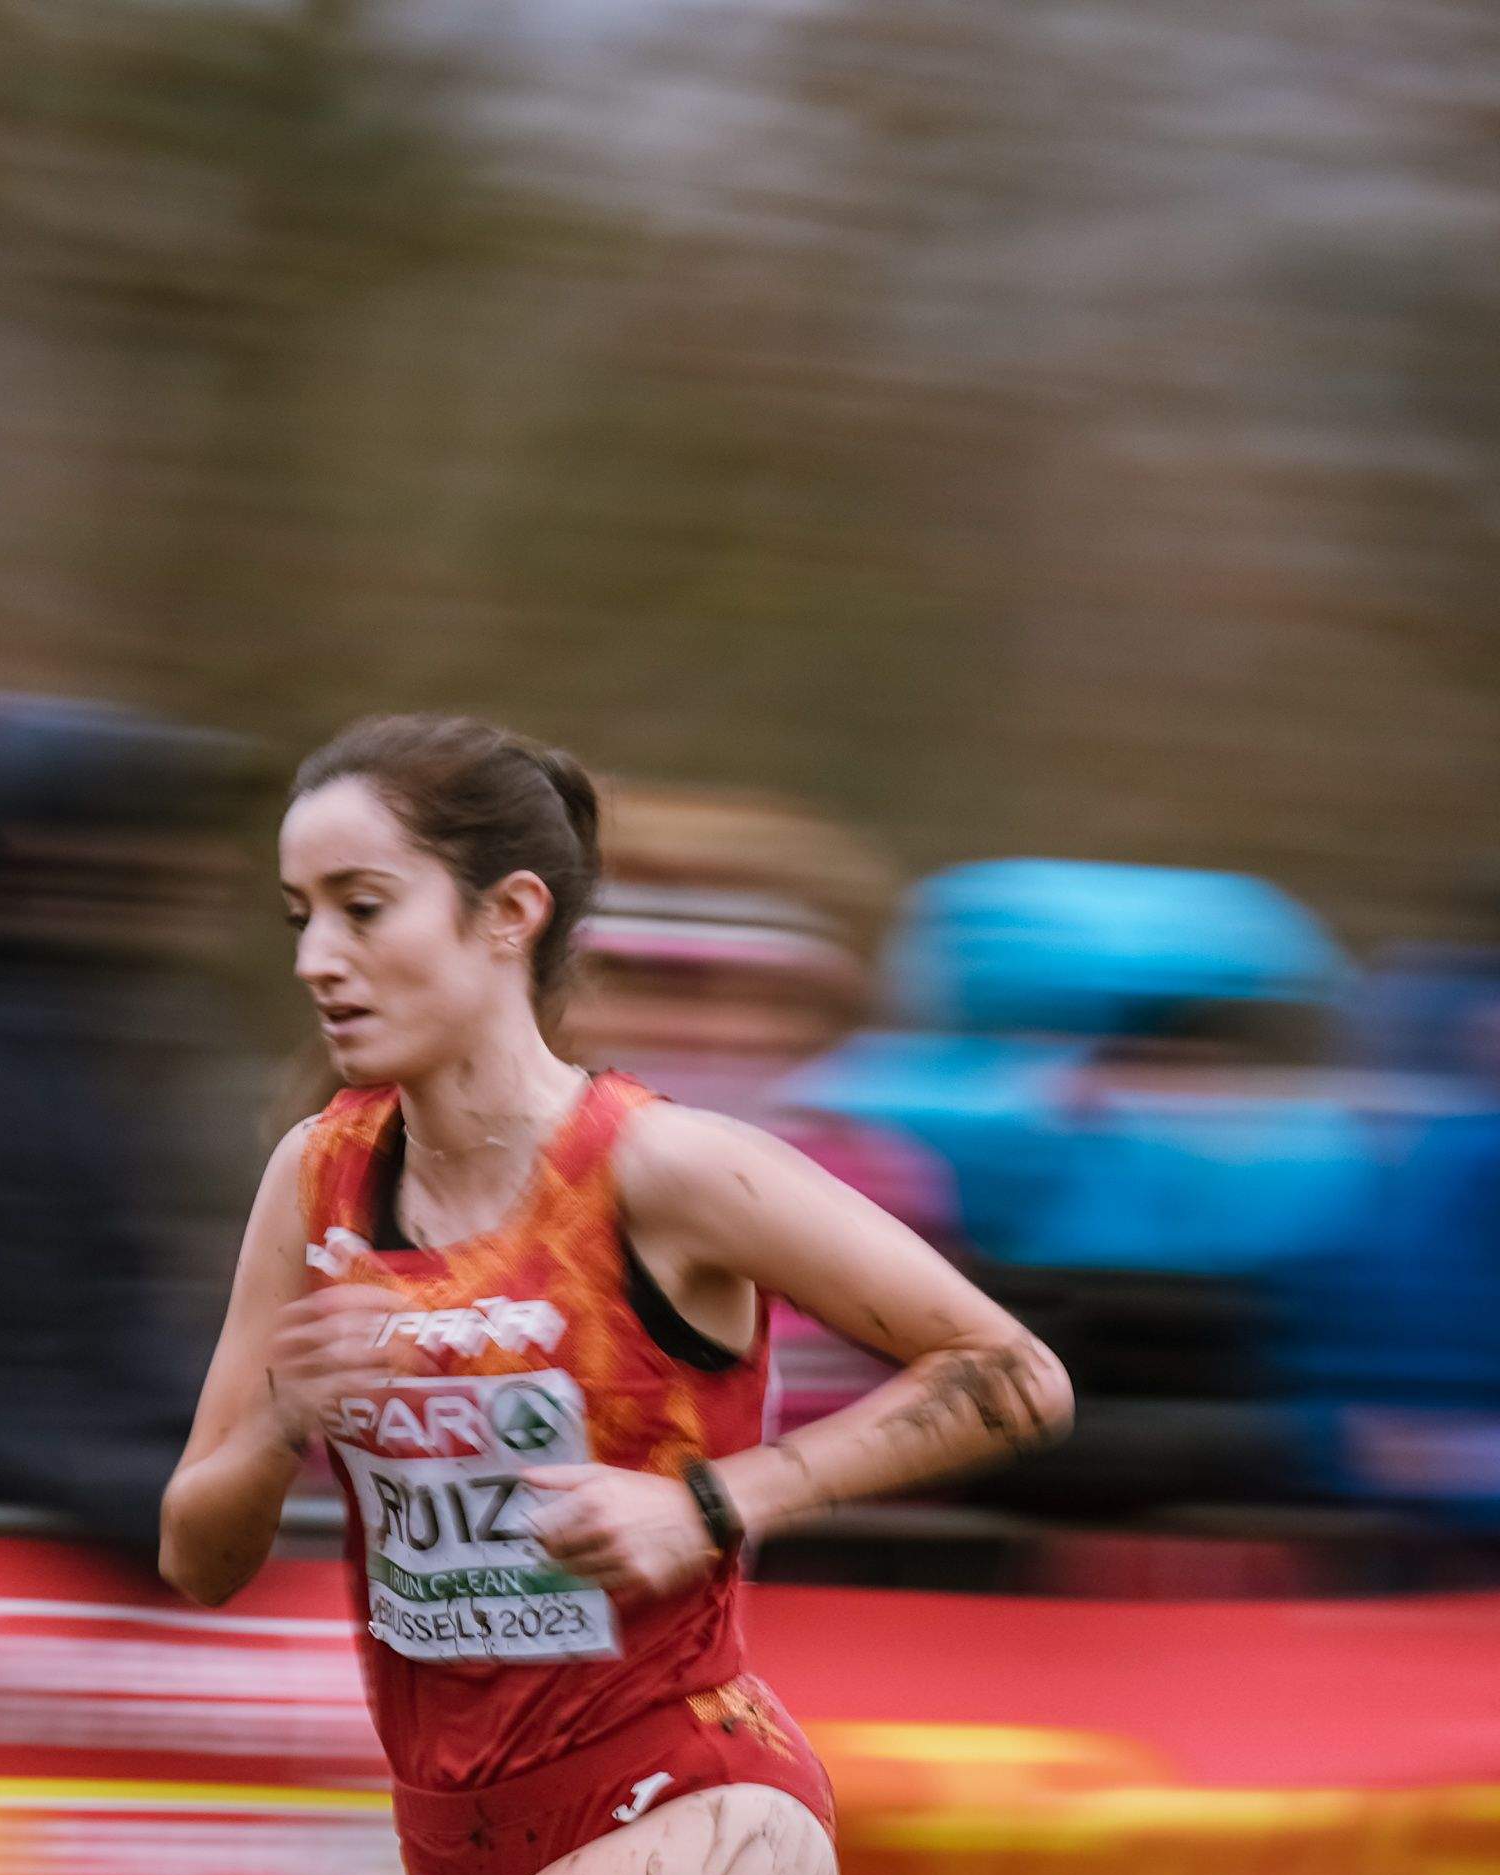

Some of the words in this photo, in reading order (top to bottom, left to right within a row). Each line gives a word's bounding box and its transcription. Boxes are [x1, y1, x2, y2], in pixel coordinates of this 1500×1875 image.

[369, 1471, 529, 1551] RUIZ
[393, 1566, 426, 1600] RUN
[499, 1603, 587, 1638] 2023
